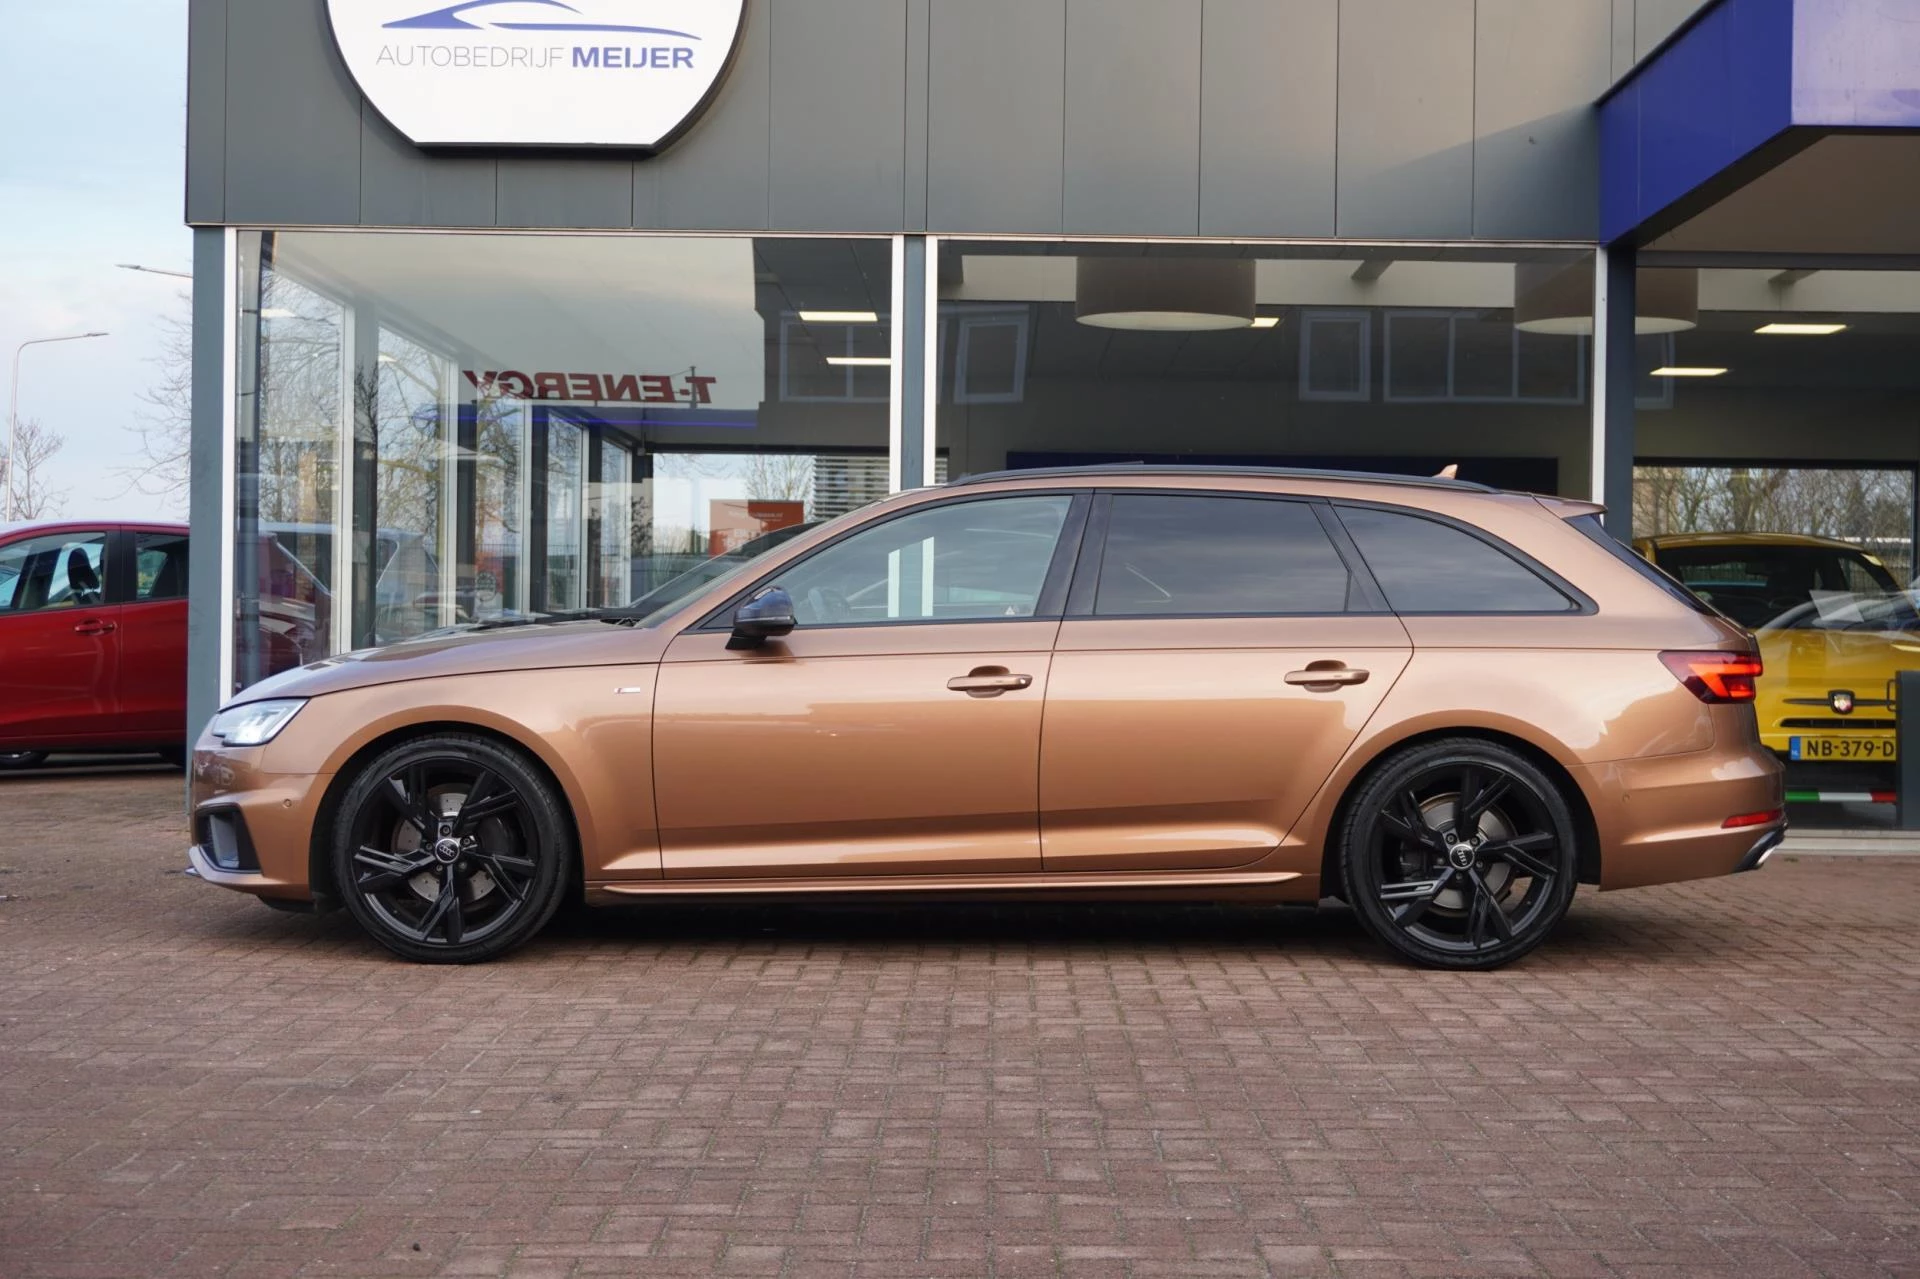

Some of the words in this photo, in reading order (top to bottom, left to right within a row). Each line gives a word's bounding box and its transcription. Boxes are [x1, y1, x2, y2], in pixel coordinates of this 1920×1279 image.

[376, 45, 564, 68] AUTOBEDRIJF
[572, 47, 694, 68] MEIJER
[1807, 740, 1894, 757] NB-379-D
